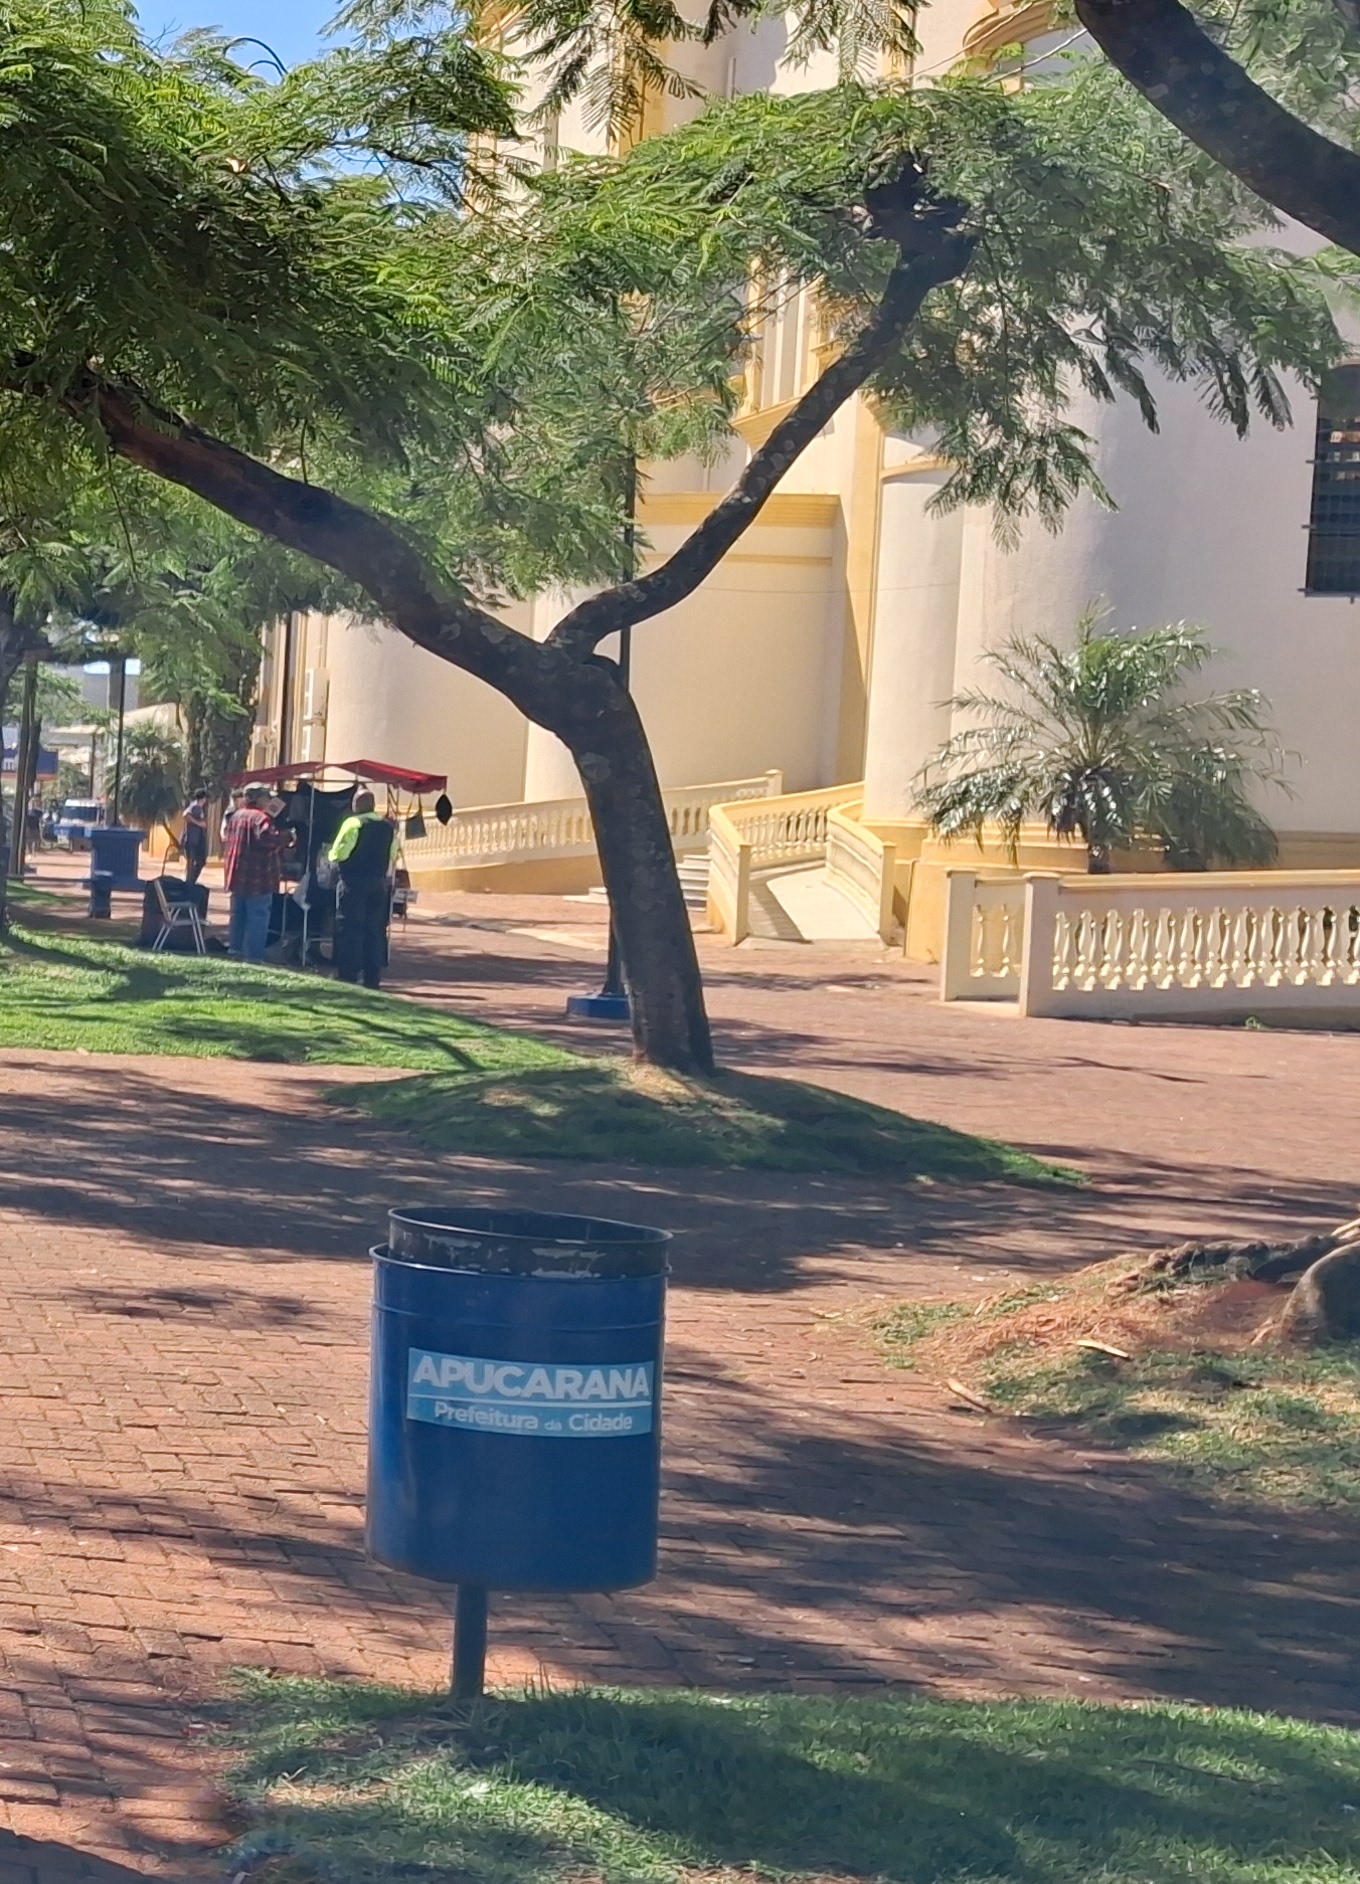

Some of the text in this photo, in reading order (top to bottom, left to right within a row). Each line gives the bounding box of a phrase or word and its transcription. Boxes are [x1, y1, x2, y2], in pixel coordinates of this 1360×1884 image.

[413, 1355, 650, 1400] APUCARANA
[434, 1401, 632, 1432] Prefeitura da Cidade
